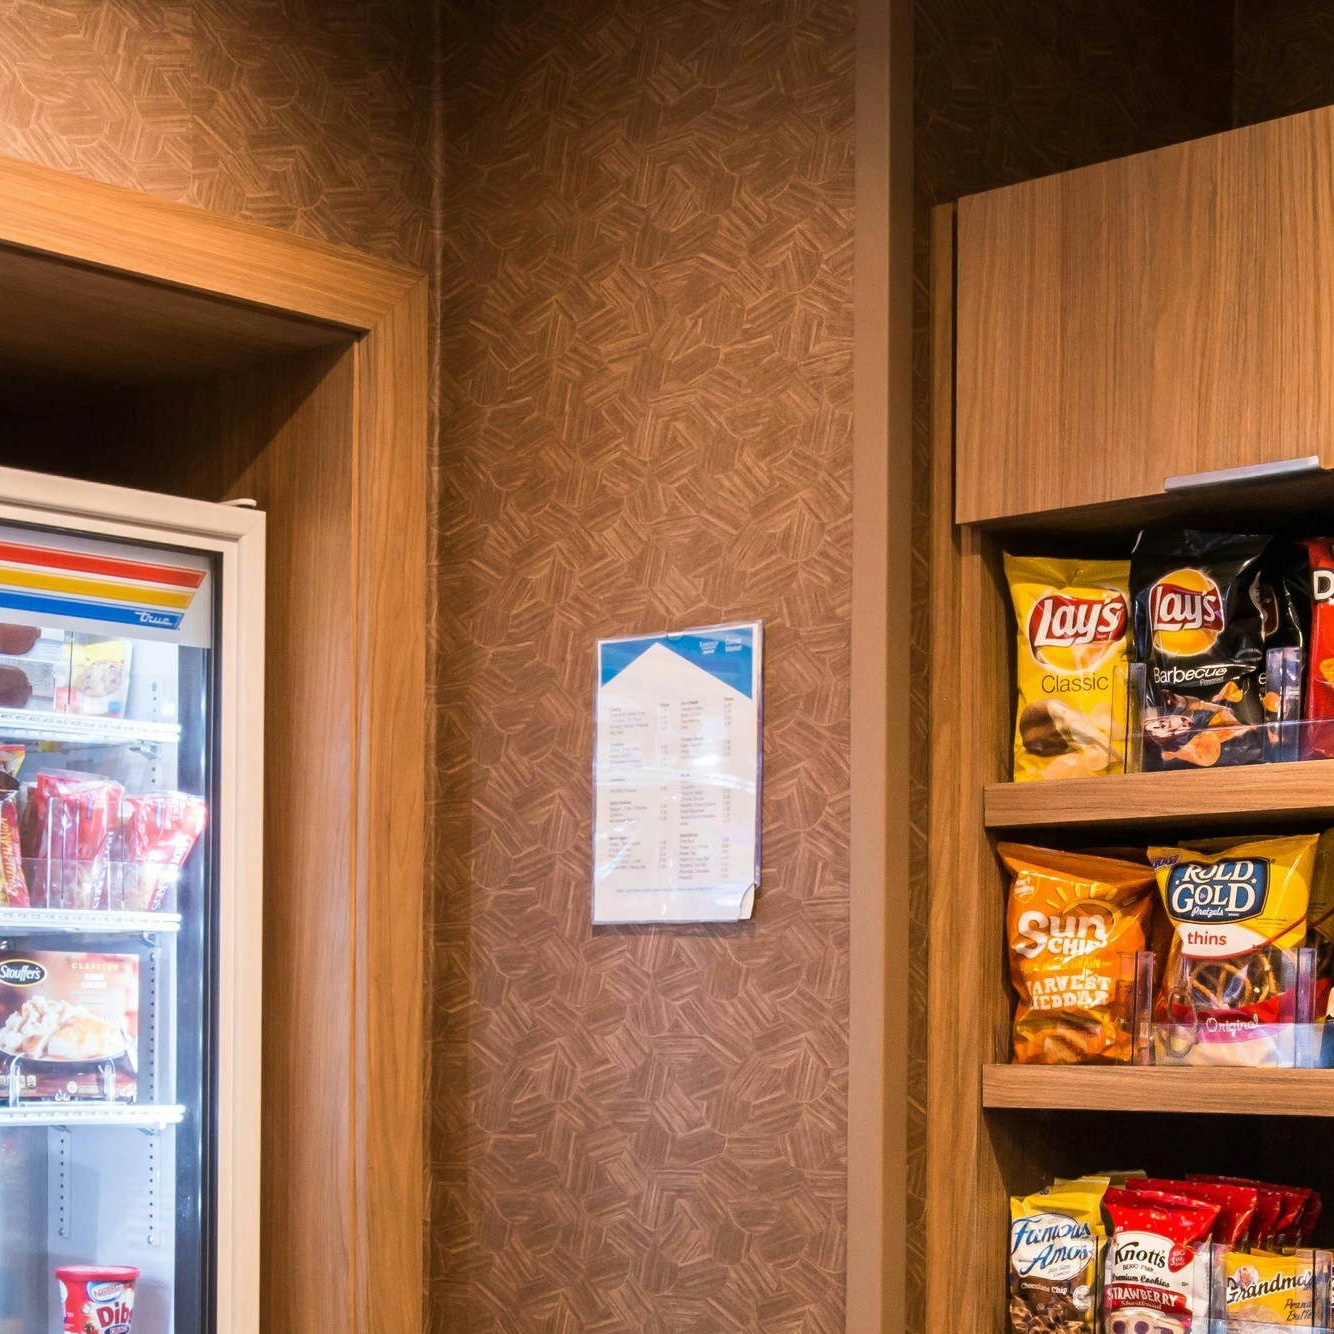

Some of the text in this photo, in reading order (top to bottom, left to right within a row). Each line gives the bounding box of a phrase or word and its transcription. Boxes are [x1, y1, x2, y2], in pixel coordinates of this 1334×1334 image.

[135, 611, 171, 626] true
[1154, 586, 1217, 631] Lay's
[1035, 596, 1121, 648] Lay's
[1041, 673, 1108, 694] Classic
[1154, 666, 1227, 684] Barbecue
[1183, 860, 1255, 883] ROLD
[1171, 882, 1256, 912] GOLD
[1191, 906, 1224, 917] Pretzels
[1187, 930, 1227, 946] thins
[0, 963, 43, 982] Stouffer's
[1015, 1218, 1091, 1246] Famous
[1019, 1244, 1095, 1276] Amos
[1116, 1241, 1166, 1269] Knott's
[1107, 1284, 1178, 1308] STRAWBERRY
